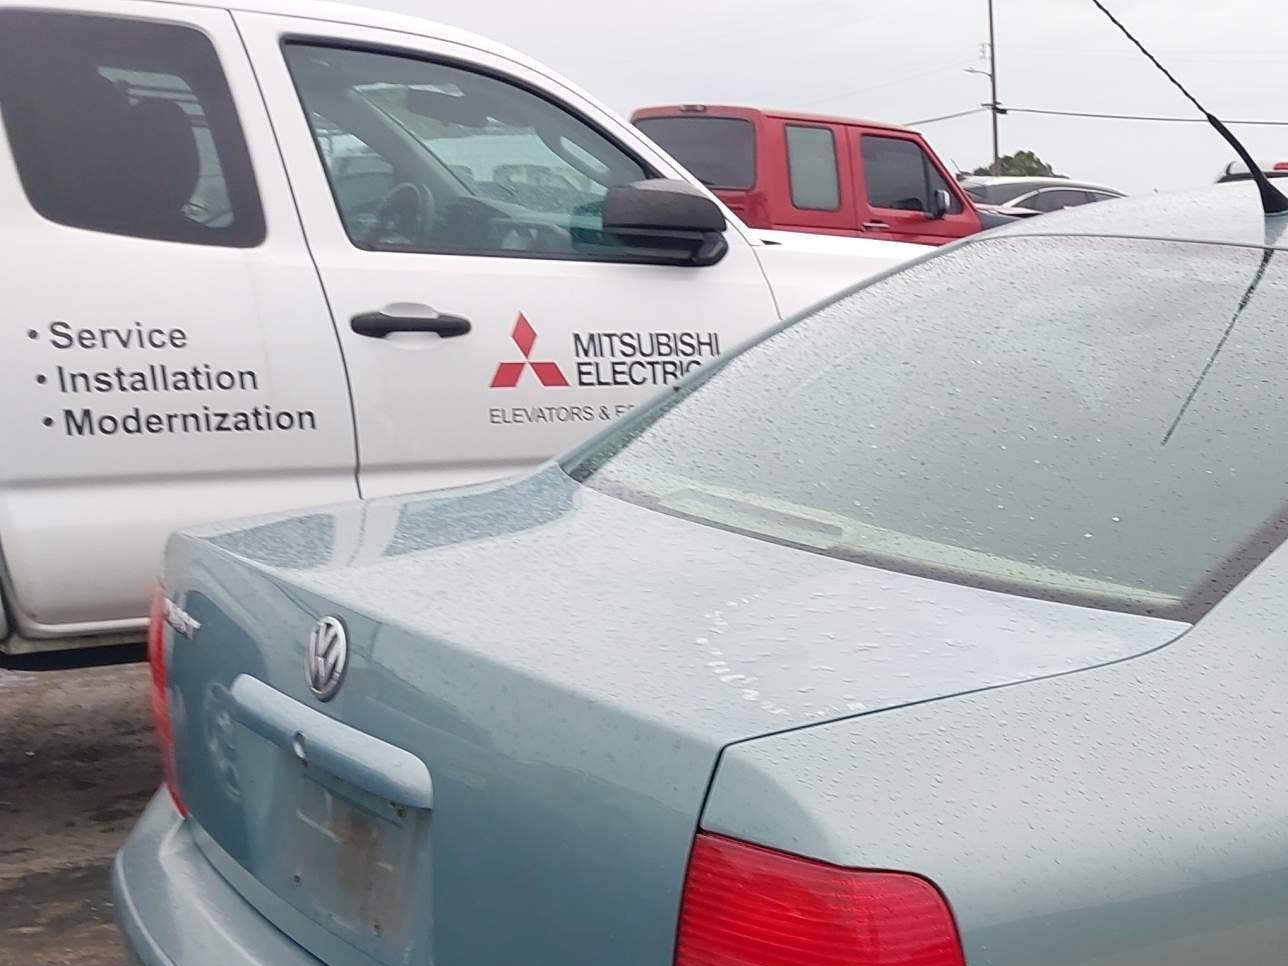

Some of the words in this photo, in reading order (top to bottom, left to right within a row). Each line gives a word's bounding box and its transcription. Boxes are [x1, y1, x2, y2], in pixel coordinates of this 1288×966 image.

[50, 321, 188, 349] Service
[573, 332, 721, 358] MITSUBISHI
[56, 364, 259, 393] Installation
[63, 405, 317, 436] Modernization
[489, 405, 594, 424] ELEVATORS
[599, 405, 611, 420] &
